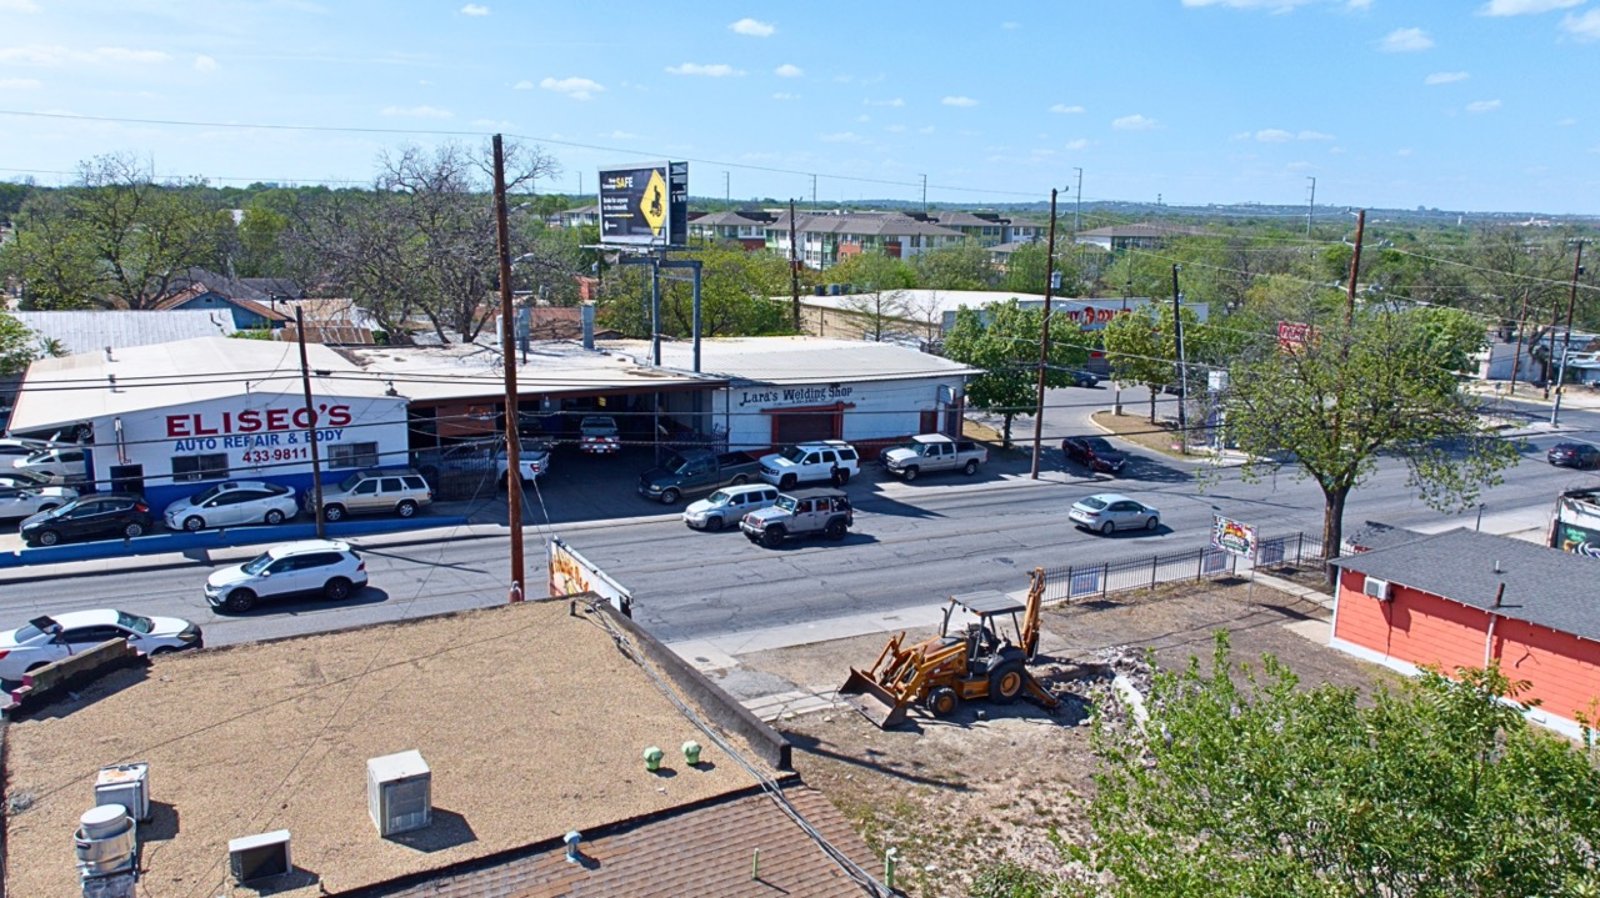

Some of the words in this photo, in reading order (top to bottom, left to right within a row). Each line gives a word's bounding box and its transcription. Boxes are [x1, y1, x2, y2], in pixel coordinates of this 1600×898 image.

[616, 176, 634, 188] SAFE
[739, 391, 778, 406] Lara's
[783, 387, 825, 401] Welding
[828, 386, 853, 398] Shop
[166, 404, 352, 437] ELISEO'S
[175, 438, 217, 451] AUTO
[224, 432, 280, 449] REPAIR
[287, 432, 298, 444] &
[304, 429, 344, 443] BODY
[242, 447, 308, 463] 433-9811
